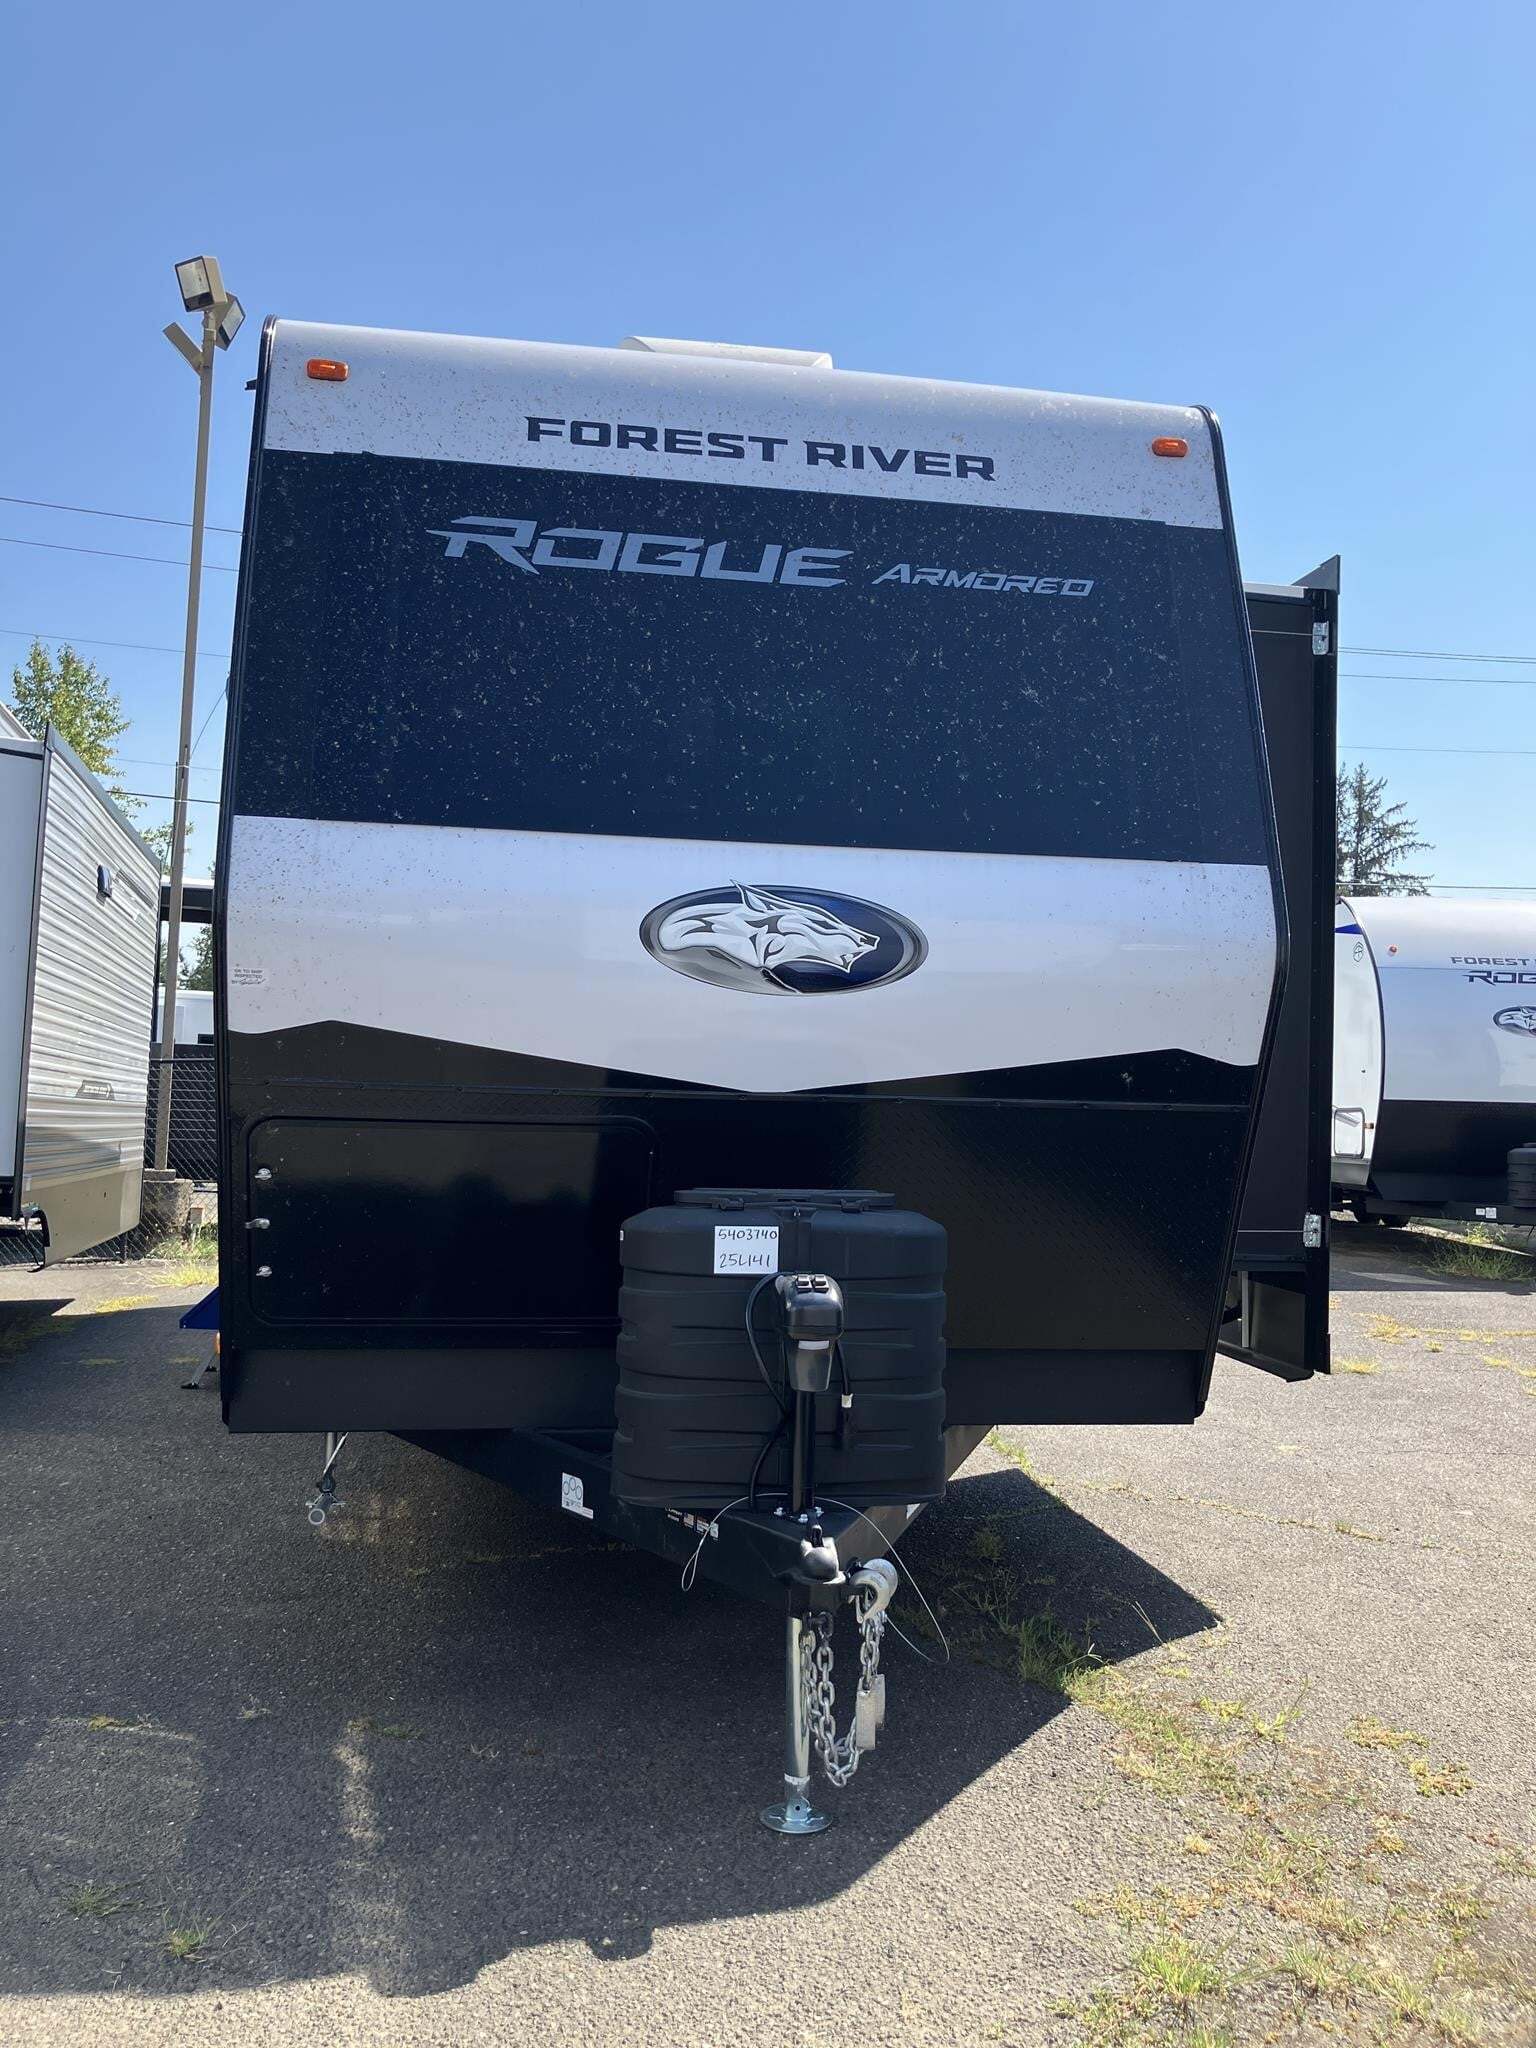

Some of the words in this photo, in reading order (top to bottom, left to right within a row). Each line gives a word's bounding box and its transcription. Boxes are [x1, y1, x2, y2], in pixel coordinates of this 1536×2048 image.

[524, 416, 788, 462] FOREST
[803, 440, 996, 482] RIVER
[426, 516, 854, 587] ROGUE
[872, 563, 1094, 597] ARMORED
[1450, 956, 1530, 966] FOREST
[718, 1228, 778, 1240] 5403740
